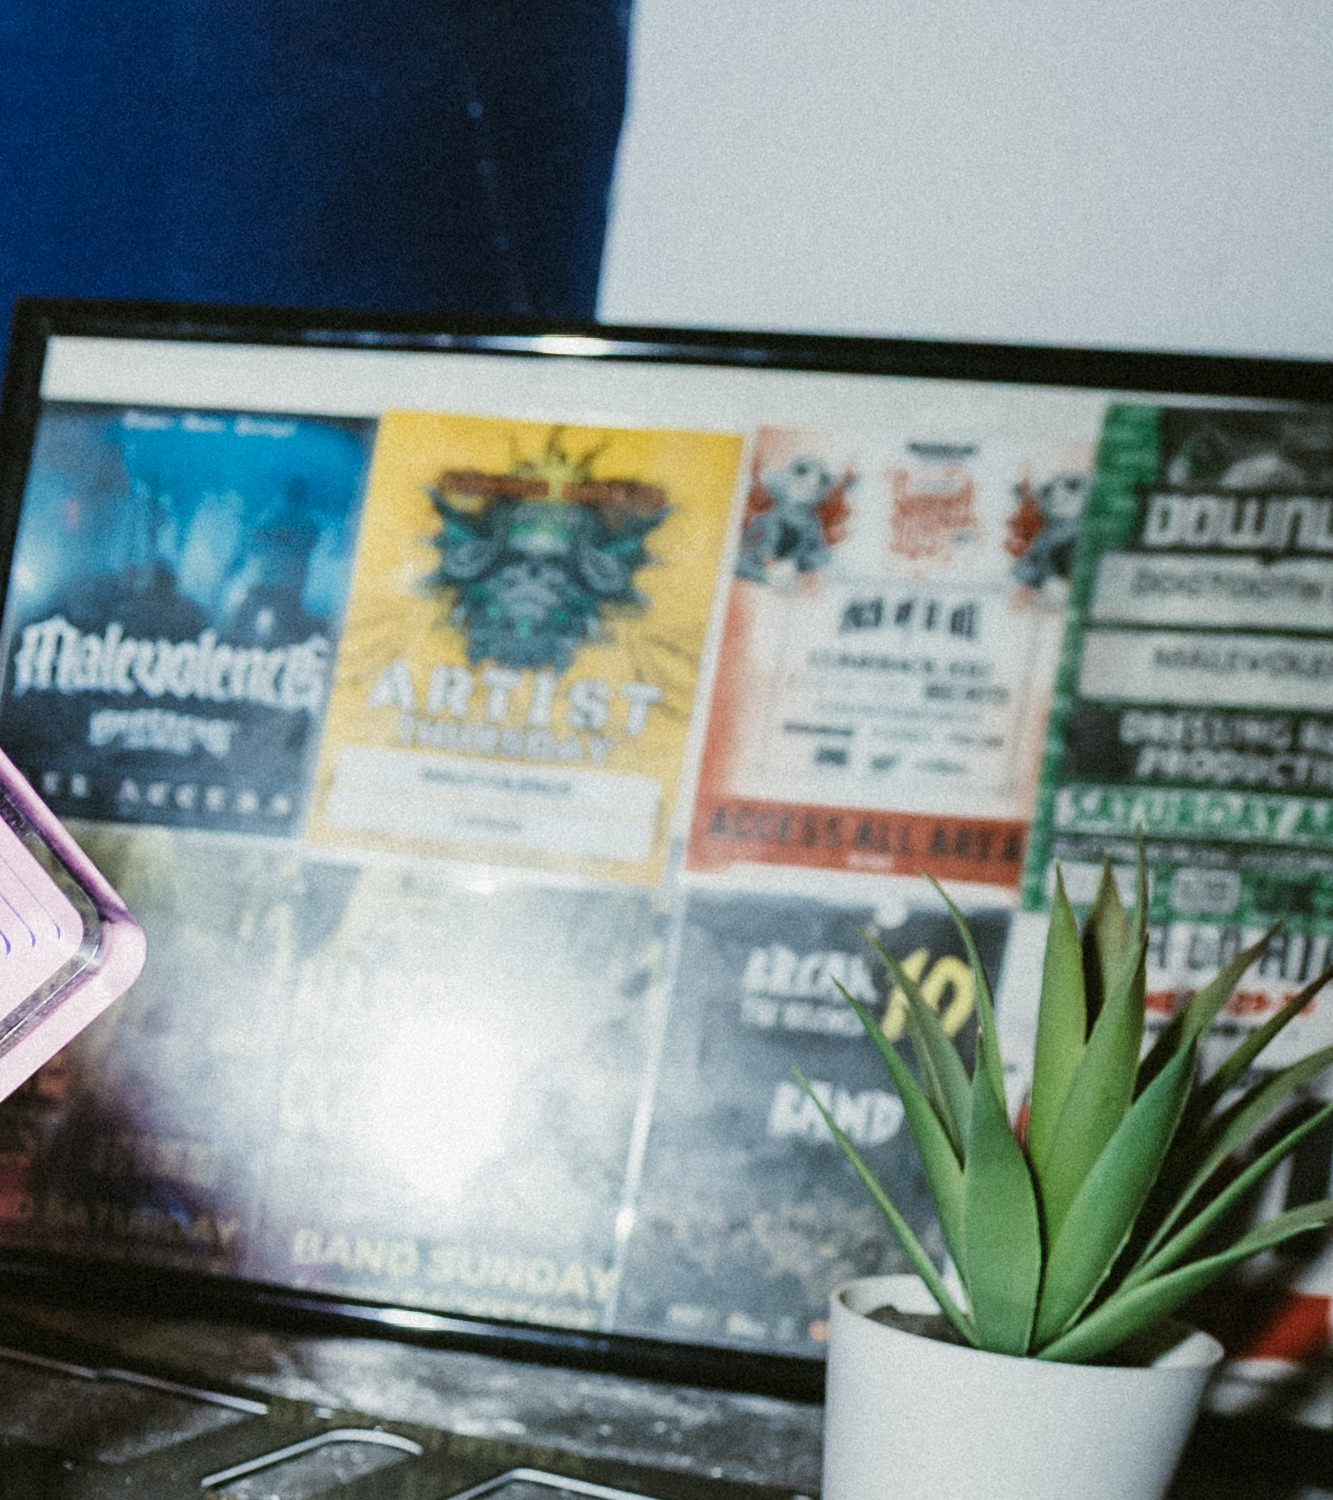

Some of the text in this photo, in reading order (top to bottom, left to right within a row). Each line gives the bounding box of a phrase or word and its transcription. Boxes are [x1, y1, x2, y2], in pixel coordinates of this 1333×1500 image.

[365, 658, 663, 736] ARTIST
[291, 1228, 420, 1279] BAND
[428, 1245, 621, 1303] SUNDAY
